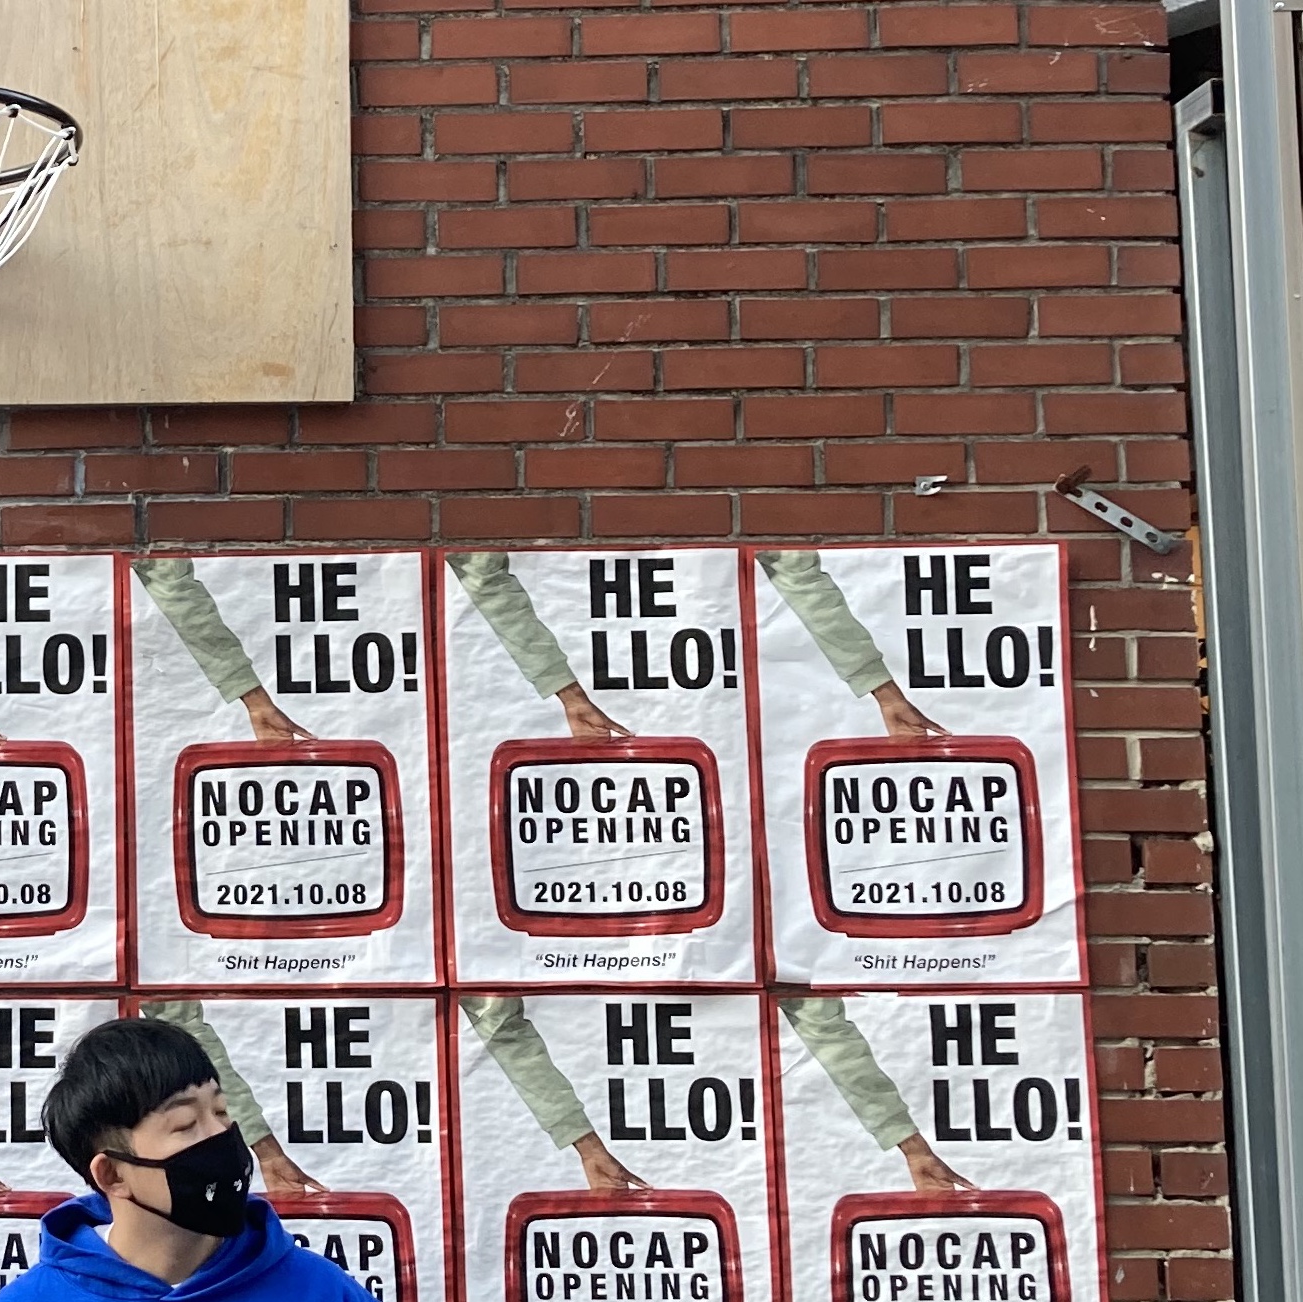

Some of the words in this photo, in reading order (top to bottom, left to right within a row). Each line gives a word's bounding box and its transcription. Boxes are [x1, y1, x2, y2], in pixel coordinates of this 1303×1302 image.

[274, 562, 358, 622] HE
[590, 558, 676, 618] HE
[904, 555, 992, 615] HE
[276, 632, 418, 694] LLO!
[592, 629, 737, 690] LLO!
[907, 626, 1054, 688] LLO!
[202, 780, 370, 816] NOCAP
[518, 777, 689, 813] NOCAP
[833, 776, 1007, 813] NOCAP
[203, 819, 370, 846] OPENING
[519, 817, 690, 843] OPENING
[835, 817, 1008, 844] OPENING
[217, 884, 365, 904] 2021.10.08
[535, 882, 686, 902] 2021.10.08
[852, 882, 1004, 903] 2021.10.08
[285, 1007, 372, 1068] HE
[606, 1003, 694, 1065] HE
[929, 1003, 1019, 1066] HE
[287, 1081, 432, 1144] LLO!
[608, 1078, 756, 1141] LLO!
[933, 1078, 1082, 1141] LLO!
[534, 1231, 708, 1268] NOCAP
[860, 1233, 1035, 1270] NOCAP
[536, 1273, 708, 1300] OPENING
[863, 1274, 1036, 1301] OPENING
